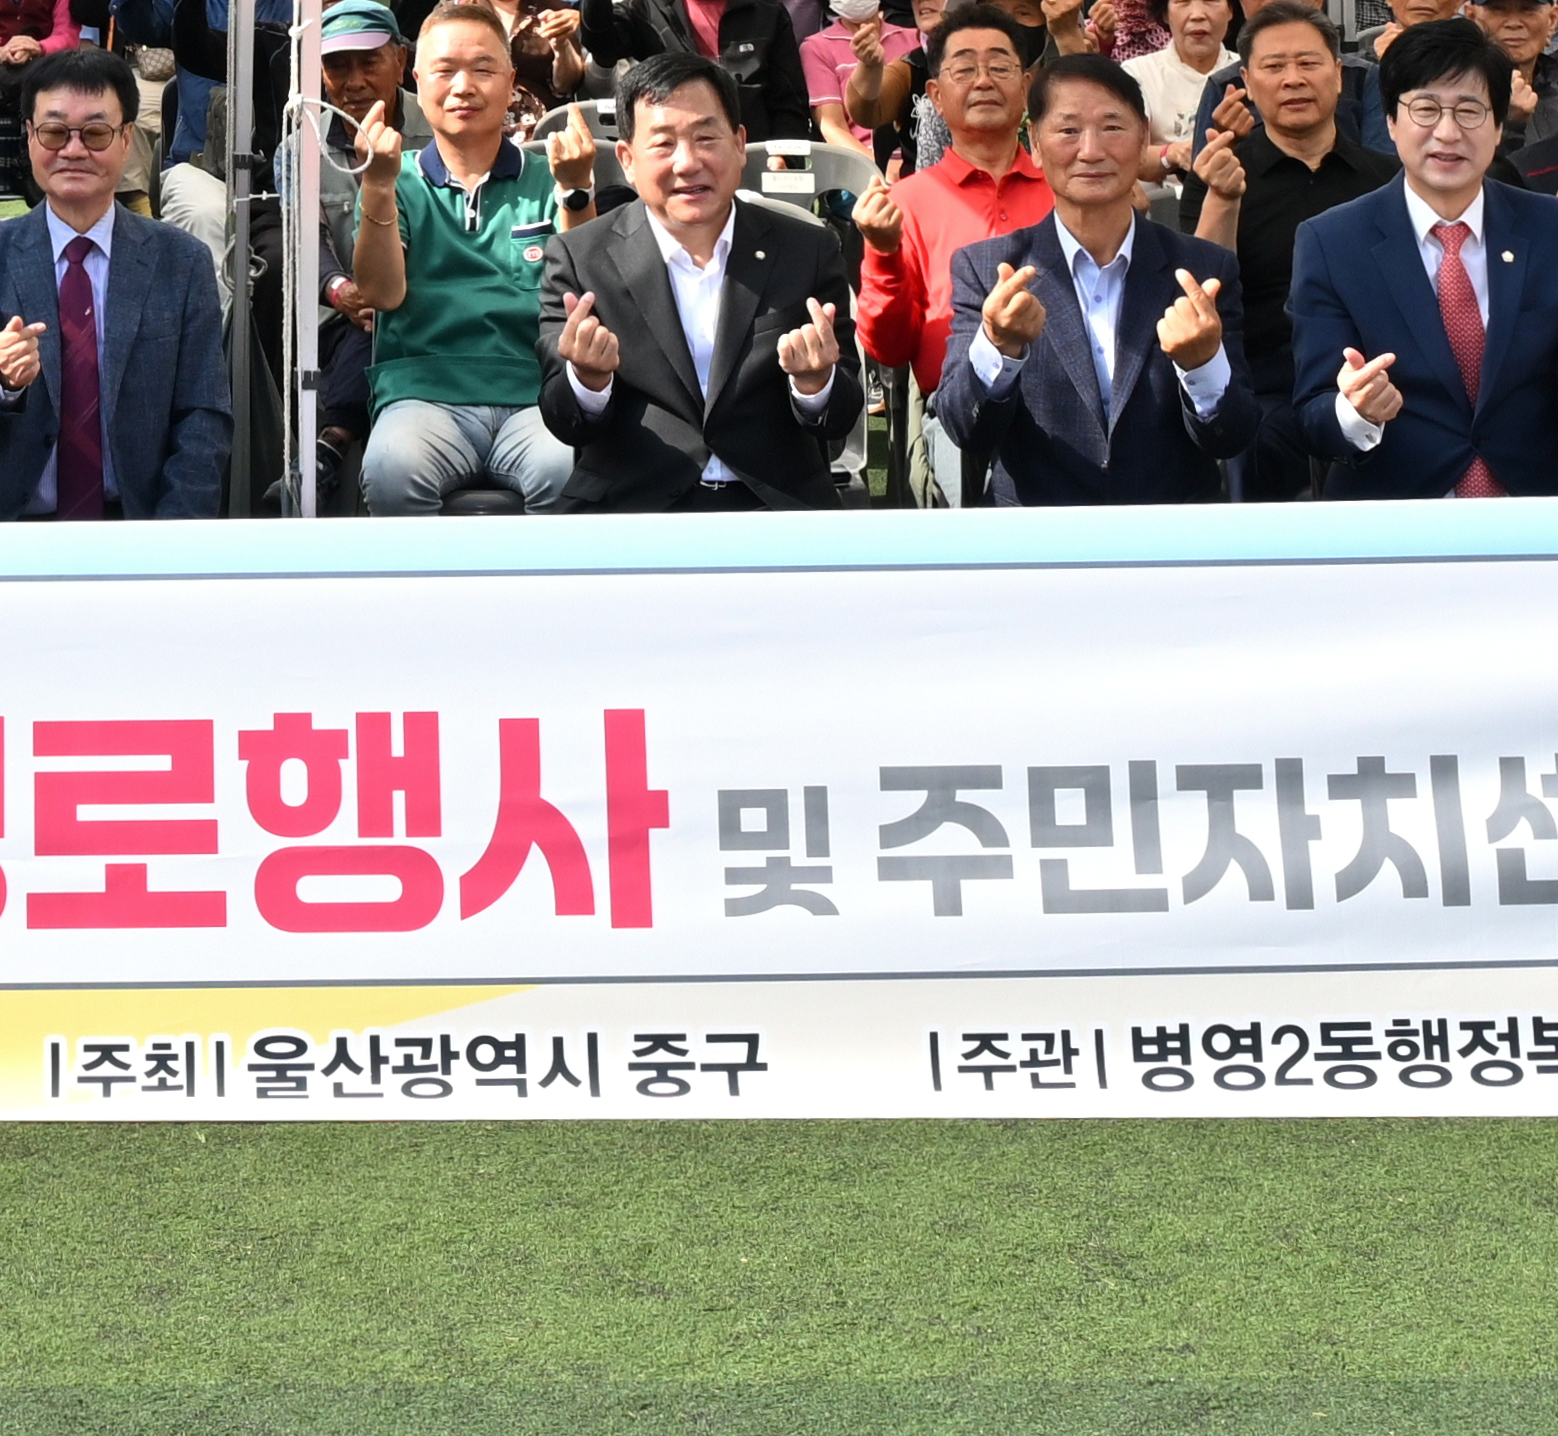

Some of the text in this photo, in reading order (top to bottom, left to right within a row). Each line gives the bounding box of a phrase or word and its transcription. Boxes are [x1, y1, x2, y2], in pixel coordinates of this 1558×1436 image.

[717, 785, 840, 917] 및
[247, 1031, 601, 1099] 울산광역시
[627, 1032, 769, 1097] 중구
